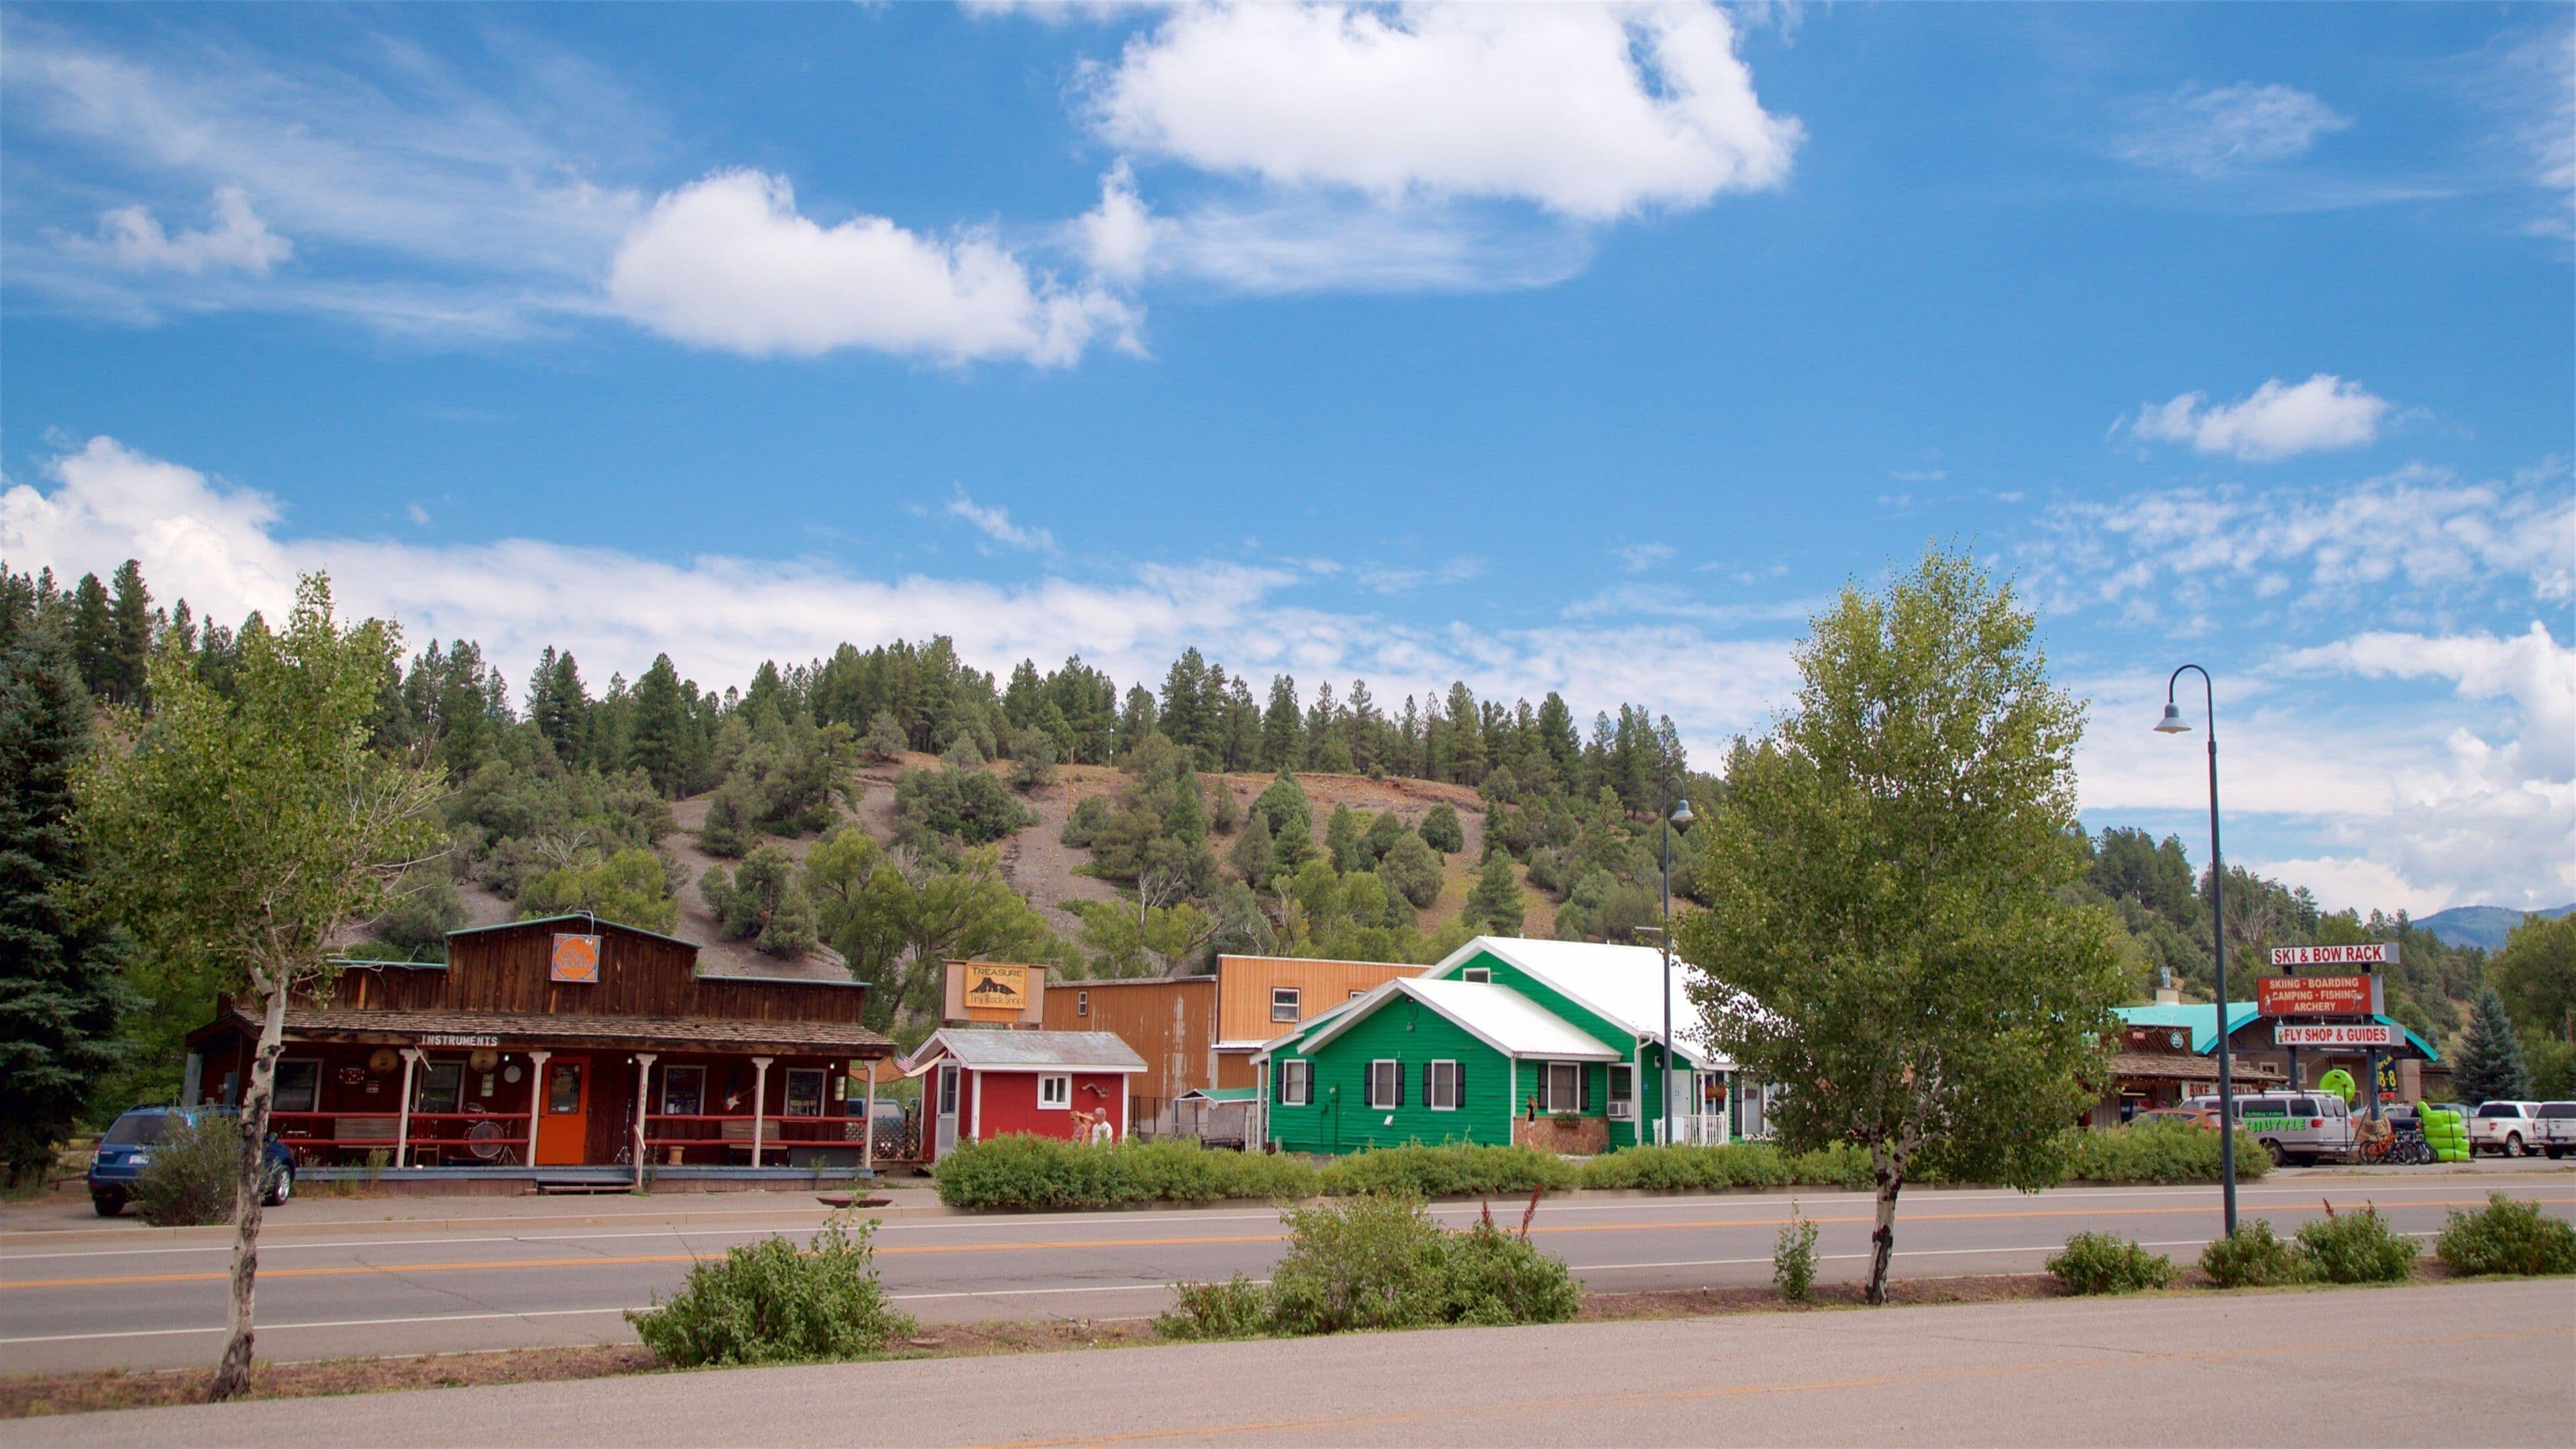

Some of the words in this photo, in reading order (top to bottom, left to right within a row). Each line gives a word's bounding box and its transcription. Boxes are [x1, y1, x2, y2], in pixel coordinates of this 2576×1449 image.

[2274, 949, 2295, 963] SKI
[2300, 949, 2308, 962] &
[2314, 947, 2342, 962] BOW
[2347, 946, 2382, 961] RACK
[971, 967, 1023, 977] TREASURE
[2269, 979, 2300, 989] SKIING
[2308, 977, 2359, 987] BOARDING
[2272, 991, 2313, 1001] CAMPING
[2320, 989, 2357, 999] FISHING
[2294, 1002, 2336, 1012] ARCHERY
[422, 1034, 498, 1046] INSTRUMENTS
[2284, 1028, 2302, 1041] FLY
[2305, 1028, 2332, 1041] SHOP
[2337, 1028, 2343, 1041] &
[2347, 1028, 2386, 1041] GUIDES
[2189, 1083, 2210, 1097] BIKE
